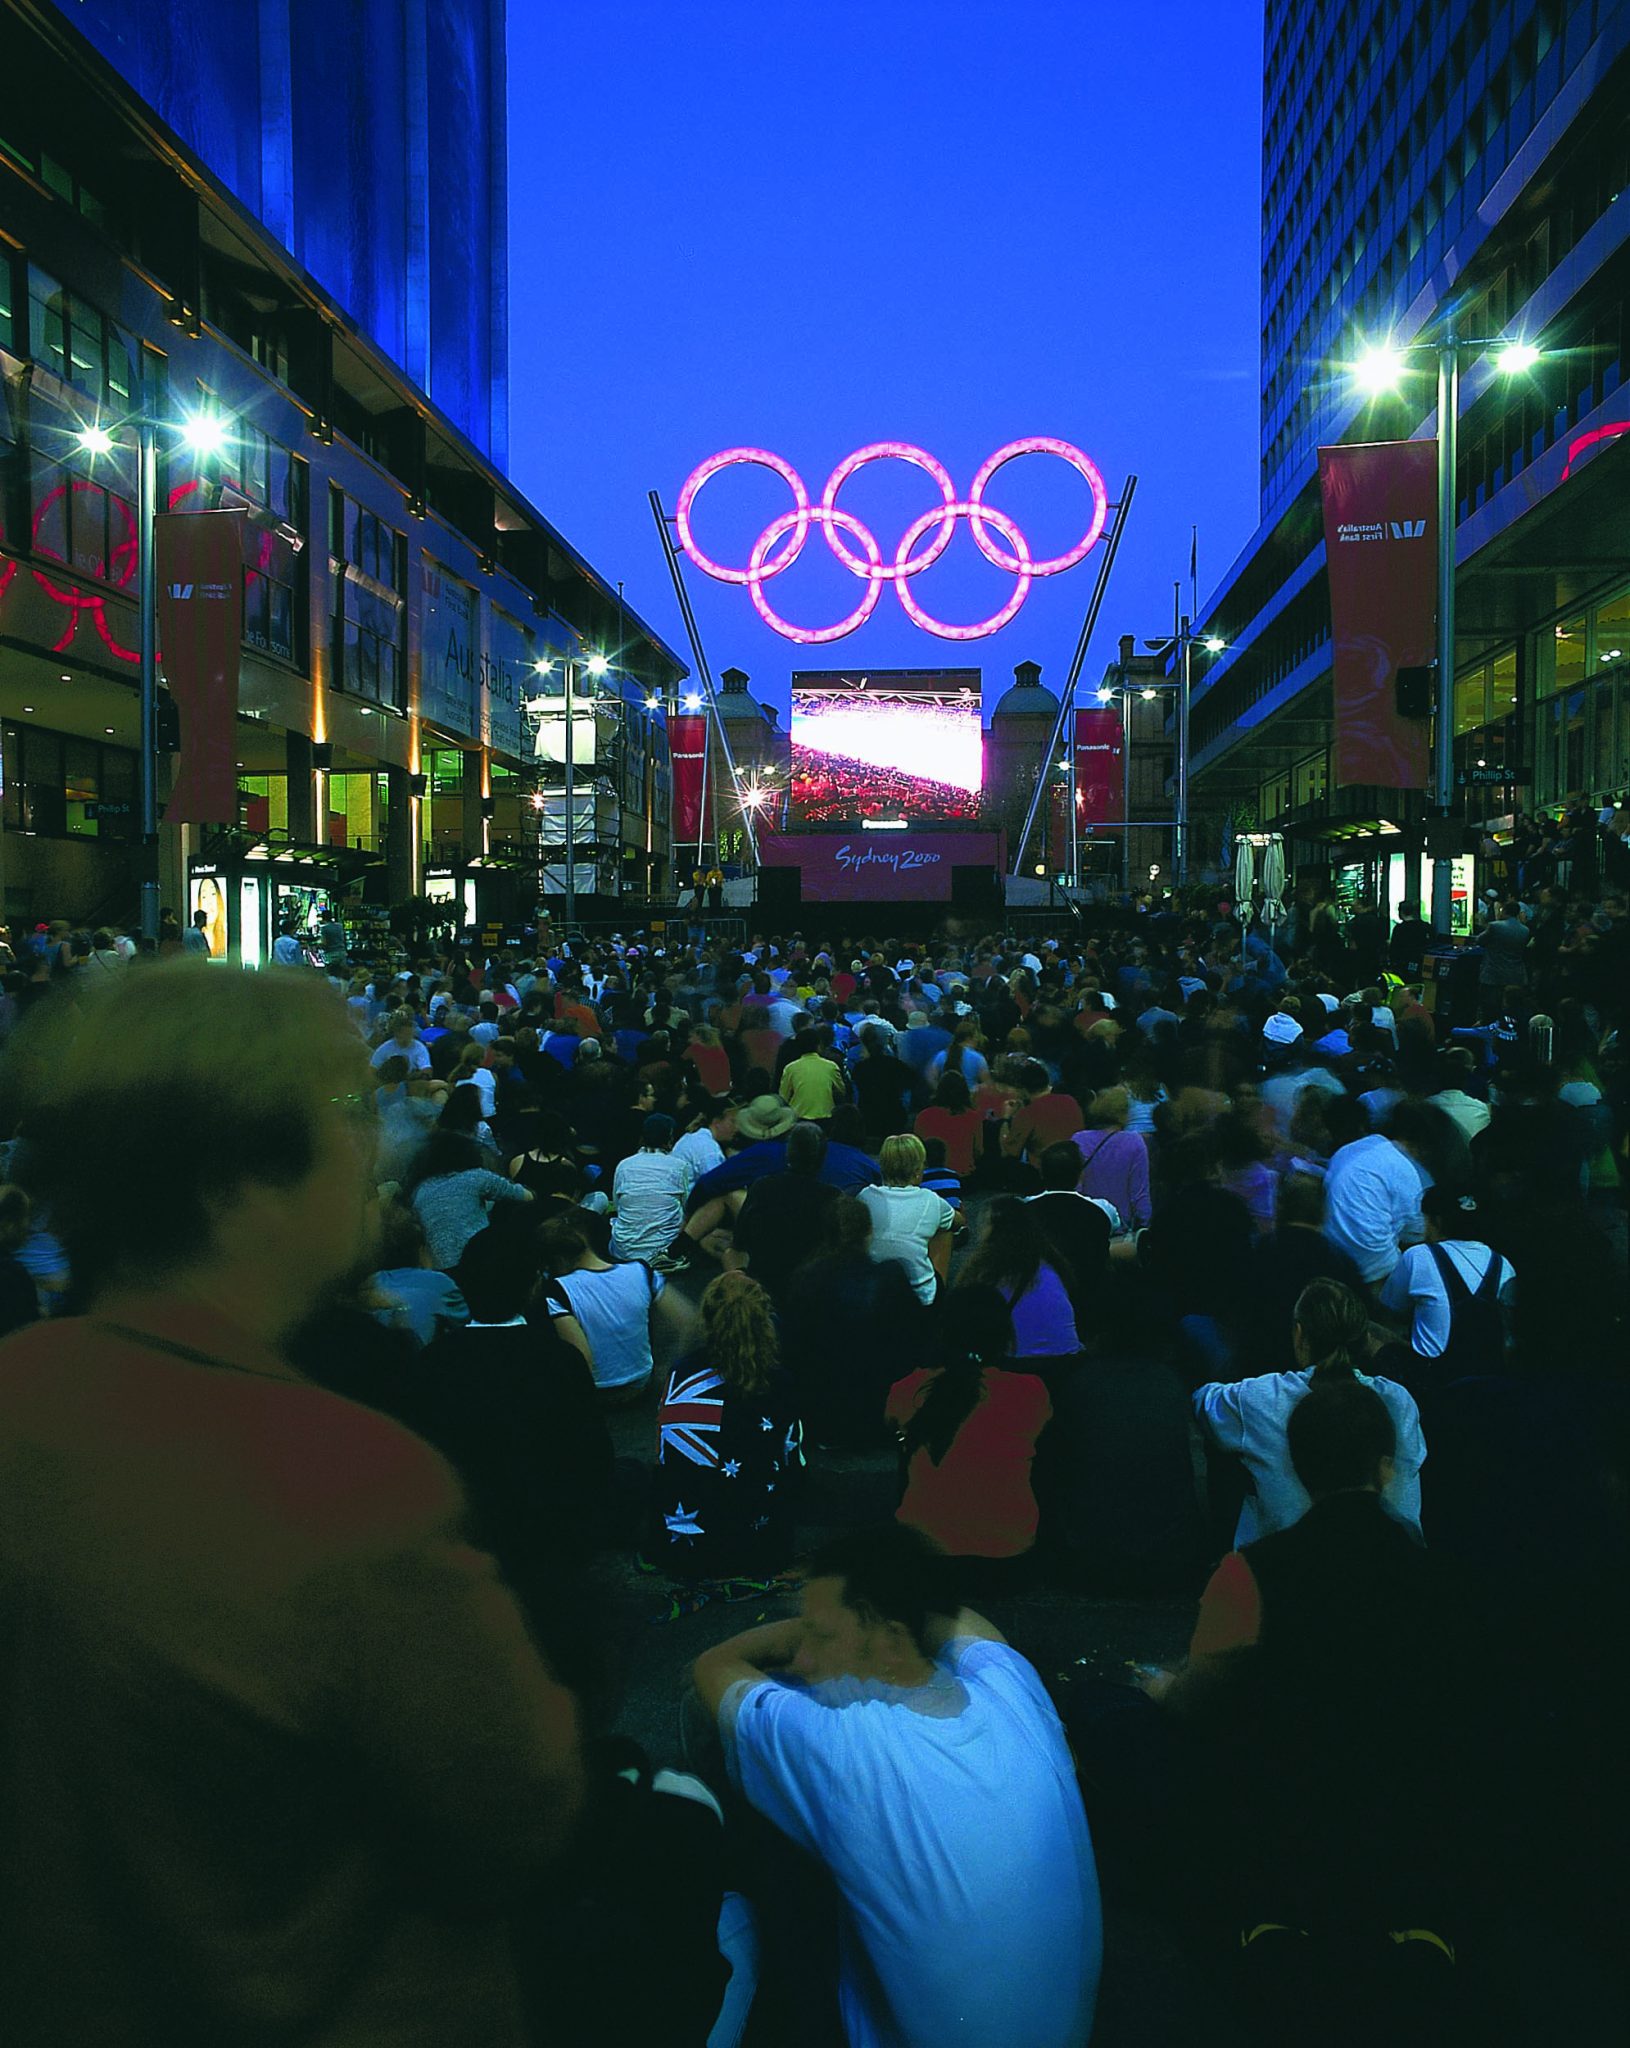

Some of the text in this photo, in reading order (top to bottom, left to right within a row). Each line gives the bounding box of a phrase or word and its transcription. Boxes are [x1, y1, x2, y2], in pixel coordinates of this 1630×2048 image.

[1472, 769, 1516, 782] Phillip St
[835, 845, 941, 873] Sydney 2000
